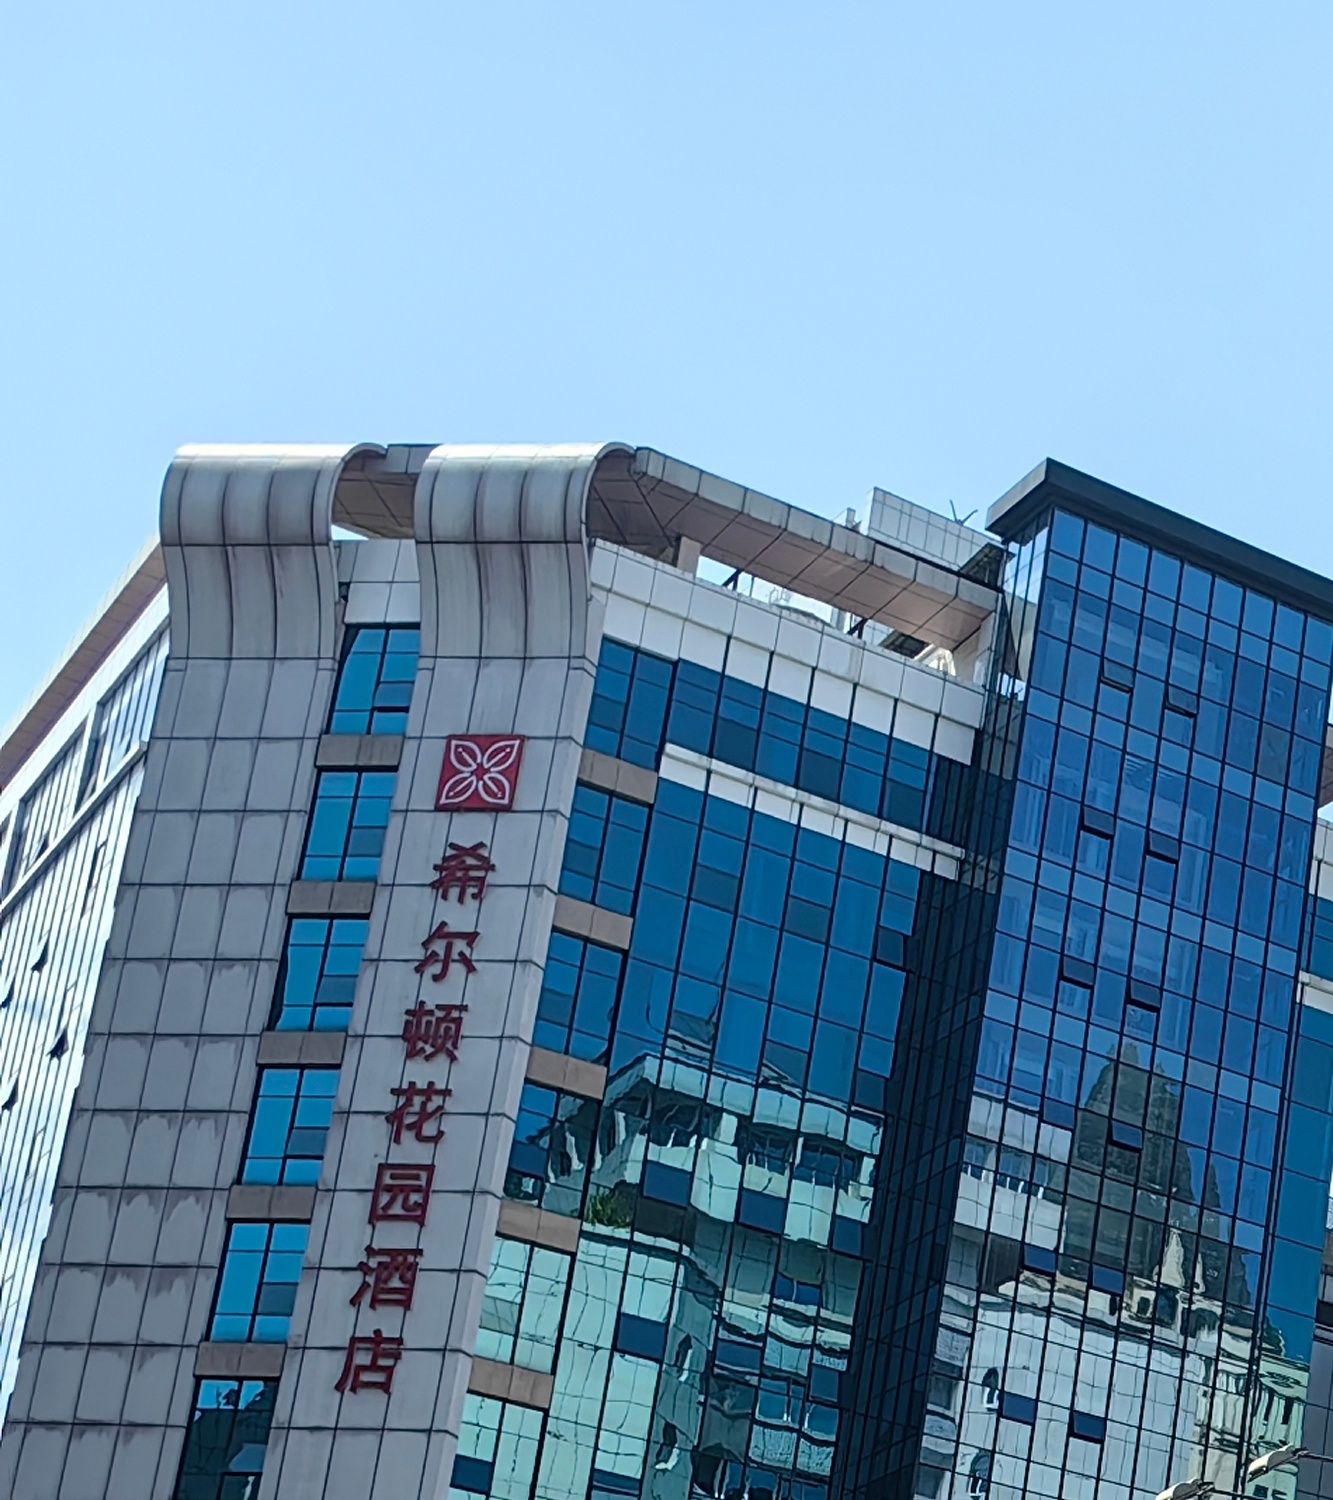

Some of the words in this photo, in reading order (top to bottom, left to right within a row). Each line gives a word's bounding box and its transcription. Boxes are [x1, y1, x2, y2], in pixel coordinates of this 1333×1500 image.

[334, 841, 495, 1397] 希尔顿花园酒店
